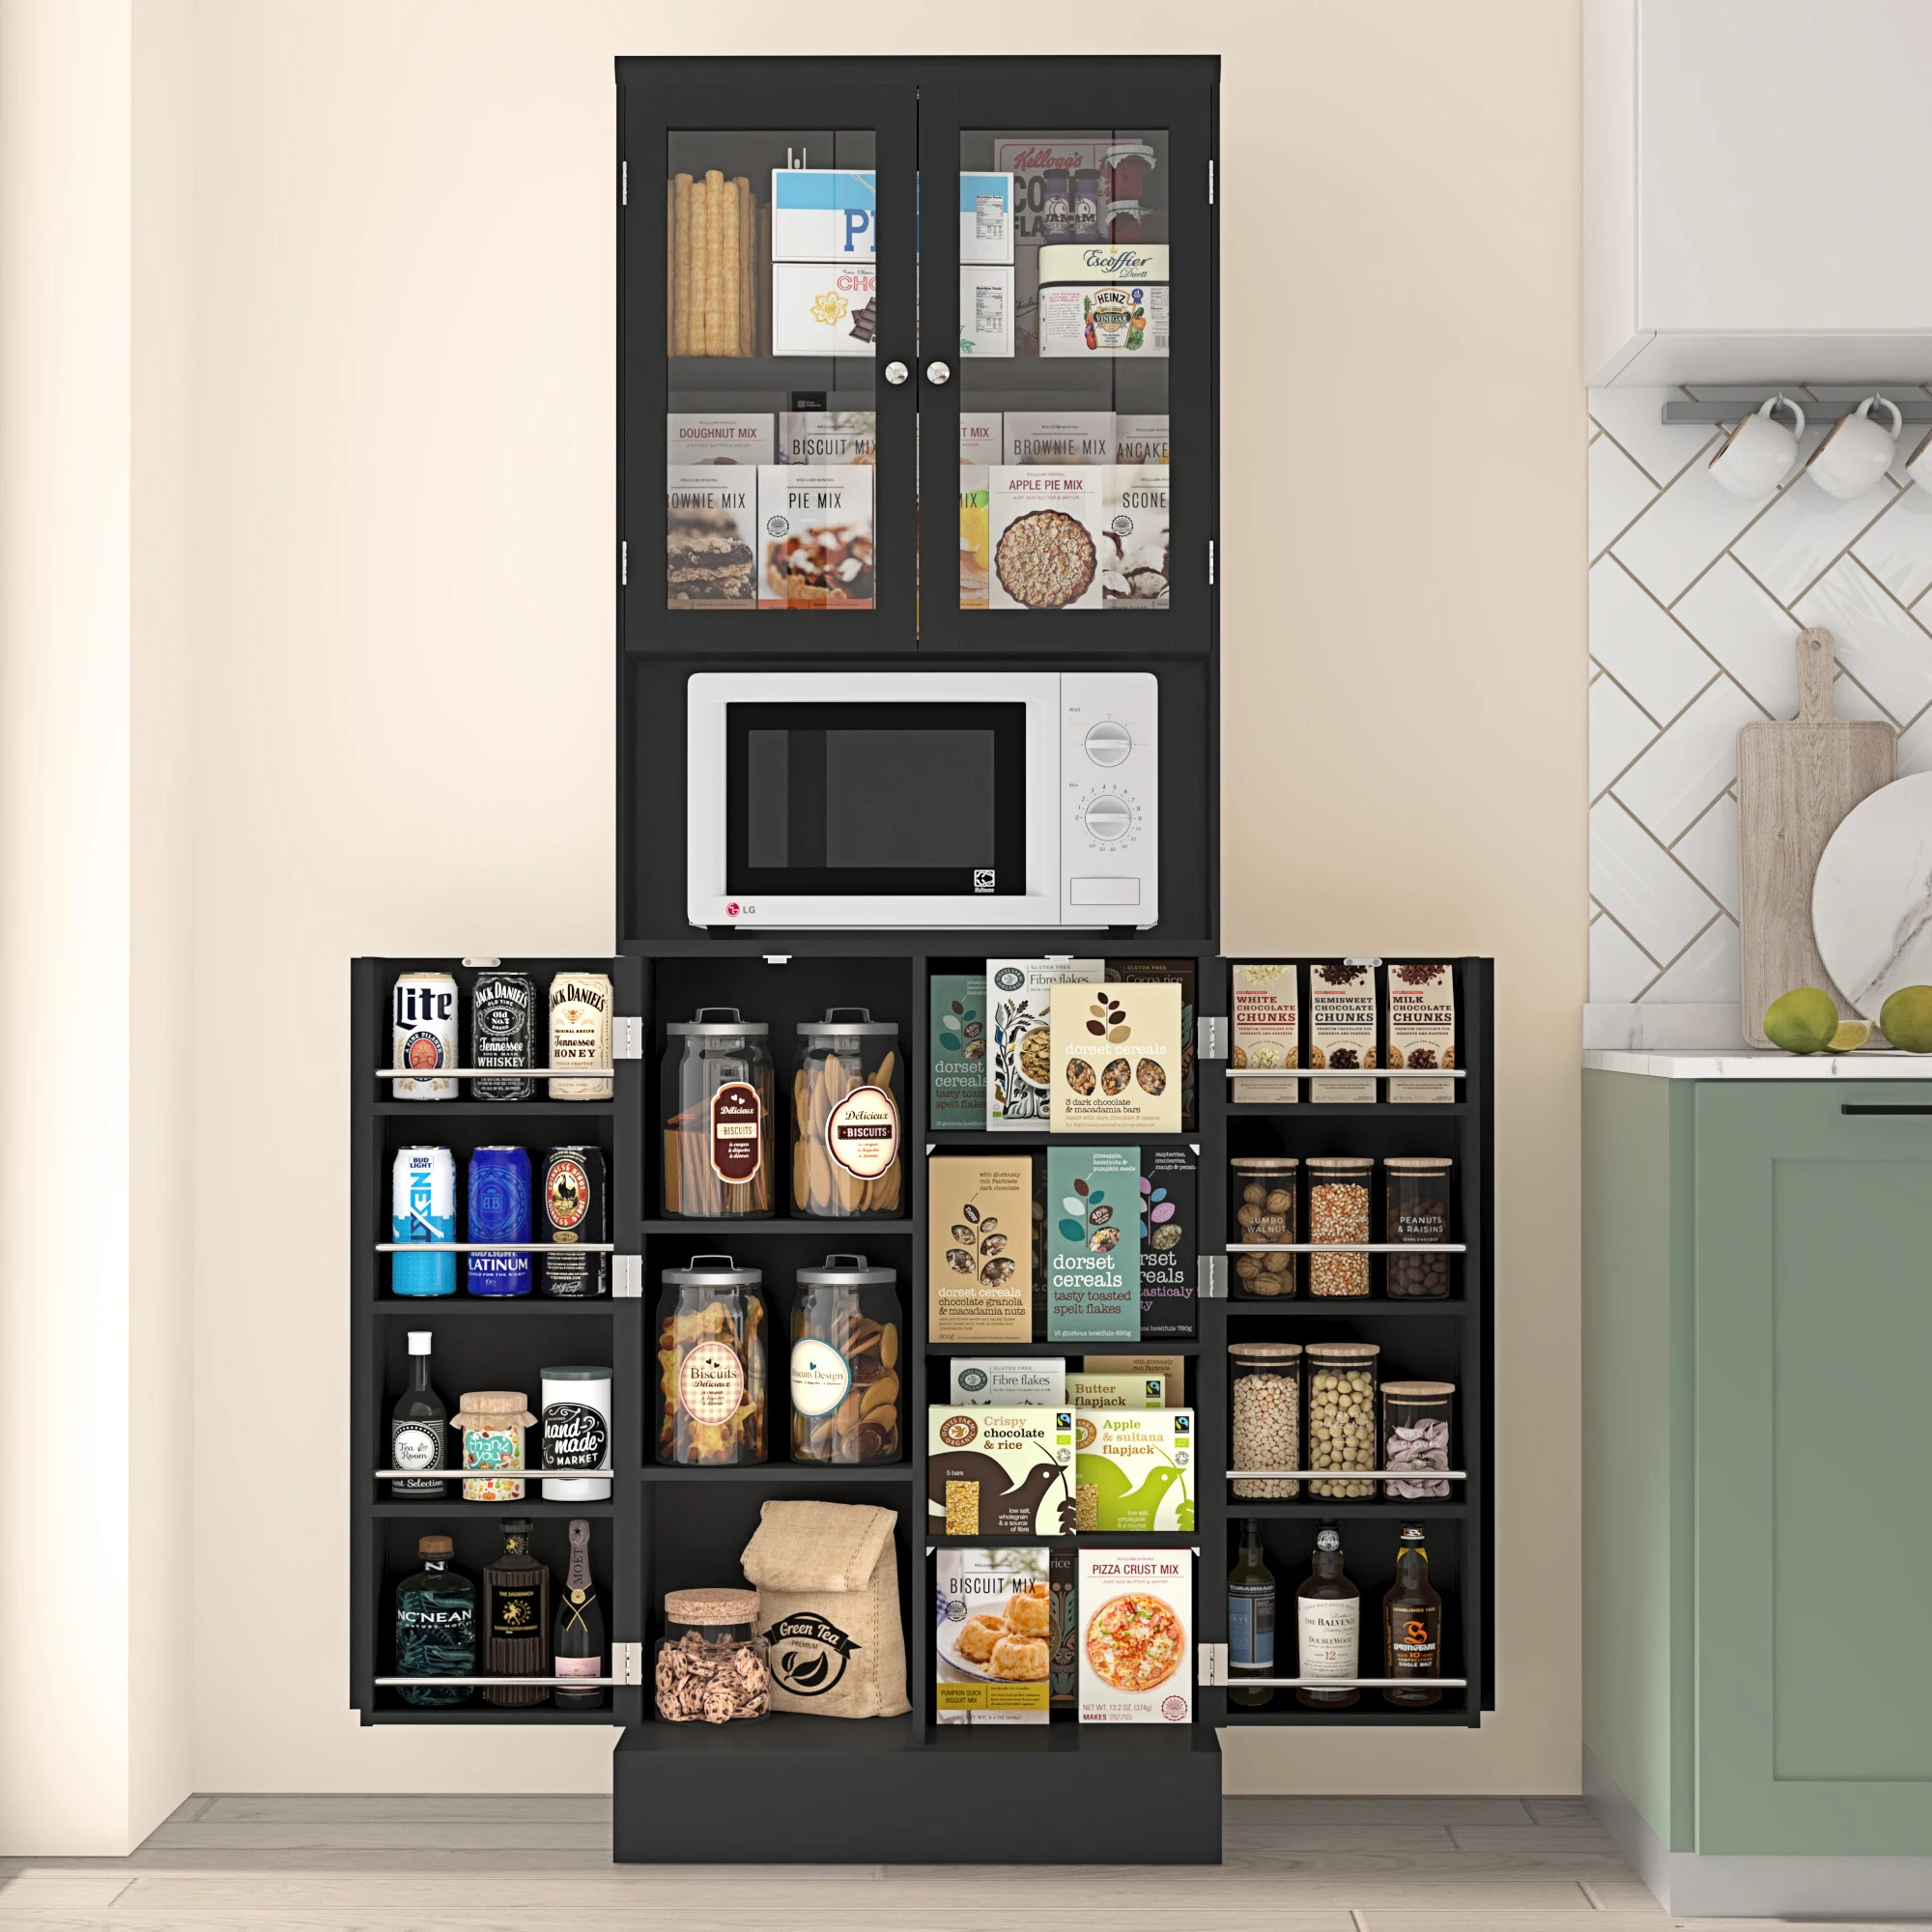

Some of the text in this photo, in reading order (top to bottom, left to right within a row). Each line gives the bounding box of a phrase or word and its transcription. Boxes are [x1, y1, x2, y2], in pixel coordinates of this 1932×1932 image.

[1013, 147, 1083, 171] Kellogg's
[1084, 249, 1152, 273] Escoffier
[1097, 293, 1126, 304] HEINZ
[679, 428, 757, 439] DOUGHNUT MIX
[971, 428, 989, 438] MIX
[793, 440, 876, 455] BISCUIT MIX
[1014, 440, 1106, 455] BROWNIE MIX
[1009, 480, 1083, 490] APPLE PIE MIX
[722, 493, 746, 509] MIX
[788, 493, 841, 509] PIE MIX
[1122, 492, 1167, 508] SCONE
[743, 905, 755, 915] LG
[1031, 974, 1090, 984] Fibre flakes
[1126, 975, 1183, 983] Cocoa rice
[475, 980, 528, 1008] JACK DANIEL'S
[550, 983, 606, 1012] JACK DANIEL'S
[396, 986, 453, 1031] Lite
[1236, 1012, 1295, 1022] CHUNKS
[1315, 1012, 1374, 1022] CHUNKS
[1393, 1012, 1452, 1022] CHUNKS
[406, 1032, 442, 1055] FINE PILSNER
[479, 1037, 524, 1052] Tennessee
[554, 1035, 596, 1047] Tennessee
[554, 1049, 596, 1058] HONEY
[1065, 1043, 1167, 1055] dorset cereals
[477, 1057, 525, 1067] WHISKEY
[935, 1061, 984, 1073] dorset
[720, 1106, 754, 1115] Délicieux
[845, 1111, 889, 1120] Délicieux
[724, 1126, 753, 1135] BISCUITS
[847, 1127, 887, 1137] BISCUITS
[549, 1163, 586, 1190] GUINNESS STOUT
[548, 1199, 586, 1226] GUINNESS STOUT
[1053, 1255, 1115, 1270] dorset
[1053, 1271, 1122, 1288] cereals
[938, 1288, 1021, 1296] dorset cereals
[1054, 1291, 1131, 1303] tasty toasted
[938, 1297, 1023, 1307] chocolate granola
[949, 1307, 1004, 1316] macadamia
[1004, 1307, 1026, 1316] nuts
[1054, 1303, 1122, 1316] spelt flakes
[691, 1367, 737, 1378] Biscuits
[814, 1370, 843, 1381] Design
[993, 1375, 1050, 1385] Fibre flakes
[1075, 1383, 1116, 1393] Butter
[1074, 1397, 1126, 1408] flapjack
[940, 1416, 975, 1438] DOVES FARM
[983, 1416, 1026, 1427] Crispy
[1102, 1419, 1141, 1431] Apple
[983, 1429, 1045, 1438] chocolate
[1102, 1433, 1164, 1442] & sultana
[469, 1434, 508, 1453] thank
[554, 1432, 598, 1454] made
[945, 1432, 977, 1447] ORGANIC
[983, 1440, 1023, 1449] & rice
[398, 1442, 415, 1452] Tea
[1102, 1445, 1155, 1457] flapjack
[401, 1451, 428, 1460] Room
[476, 1449, 501, 1465] you
[556, 1453, 599, 1465] MARKET
[407, 1479, 443, 1488] Selection
[1051, 1557, 1071, 1569] rice
[1093, 1564, 1179, 1575] PIZZA CRUST MIX
[950, 1577, 1037, 1594] BISCUIT MIX
[780, 1622, 839, 1645] Green Tea
[791, 1640, 819, 1650] PREMIUM
[1324, 1651, 1336, 1661] 12
